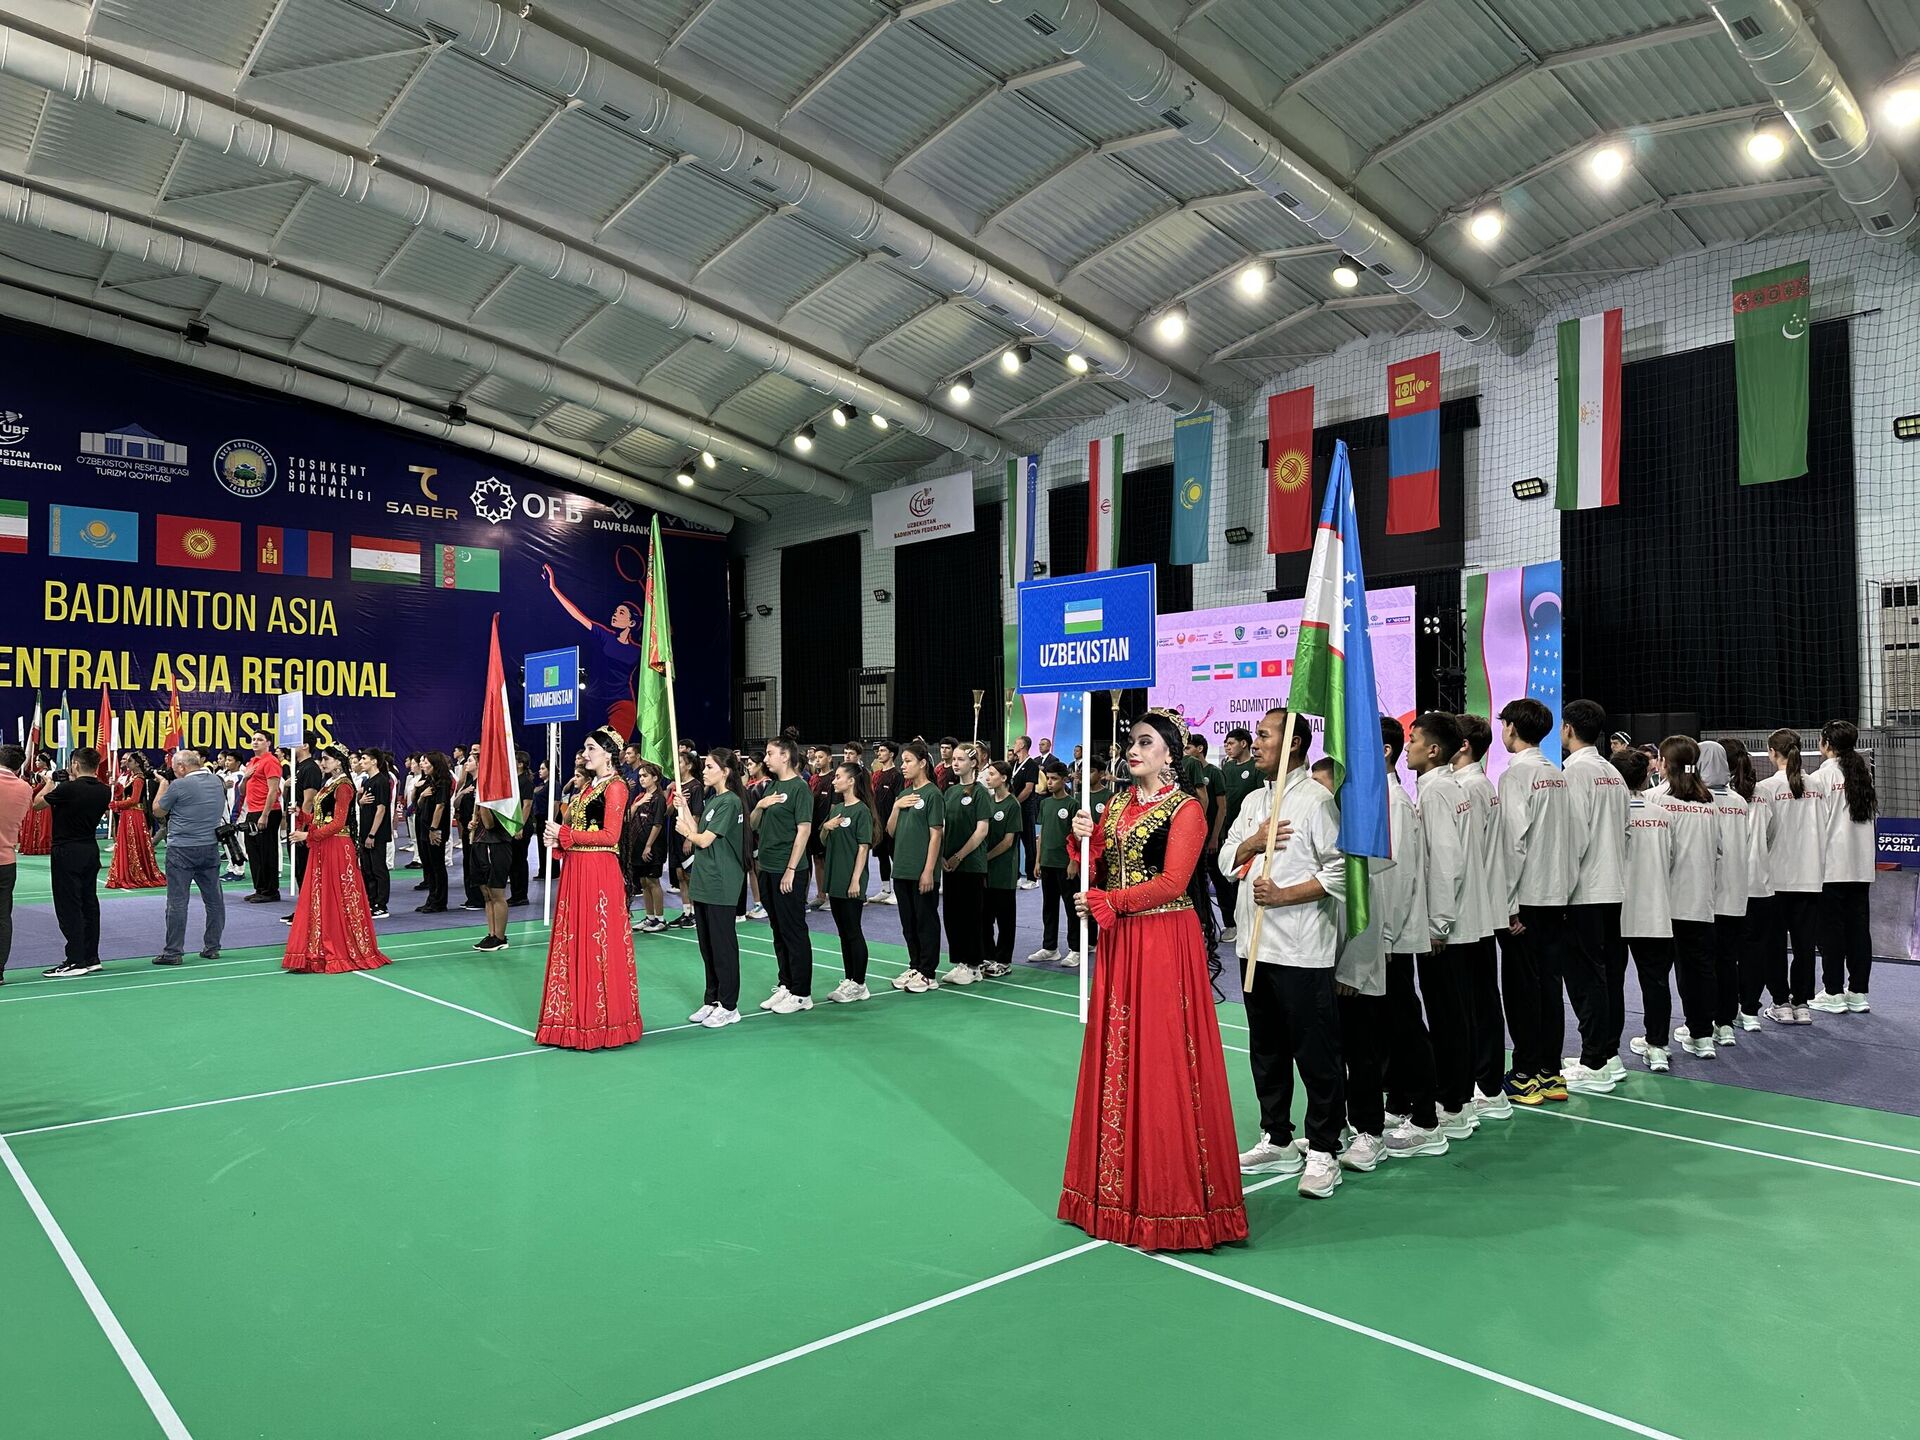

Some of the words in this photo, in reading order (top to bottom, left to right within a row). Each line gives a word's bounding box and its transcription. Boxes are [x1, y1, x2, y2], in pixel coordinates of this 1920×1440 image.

[3, 424, 30, 435] UBF
[95, 467, 127, 478] TURIZM
[288, 456, 366, 477] TOSHKENT
[288, 469, 348, 487] SHAHAR
[288, 481, 372, 502] HOKIMLIGI
[386, 501, 458, 520] SABER
[522, 493, 583, 523] OFB
[593, 519, 621, 532] DAVR
[622, 522, 650, 536] BANK
[894, 529, 921, 539] BADMINTON
[921, 523, 952, 534] FEDERATION
[44, 580, 256, 632] BADMINTON
[267, 596, 338, 637] ASIA
[1039, 637, 1130, 668] UZBEKISTAN
[150, 652, 232, 693] ASIA
[242, 656, 397, 698] REGIONAL
[528, 688, 573, 709] TURKMENISTAN
[1661, 803, 1715, 816] ZBEKISTAN
[1878, 836, 1915, 845] SPORT
